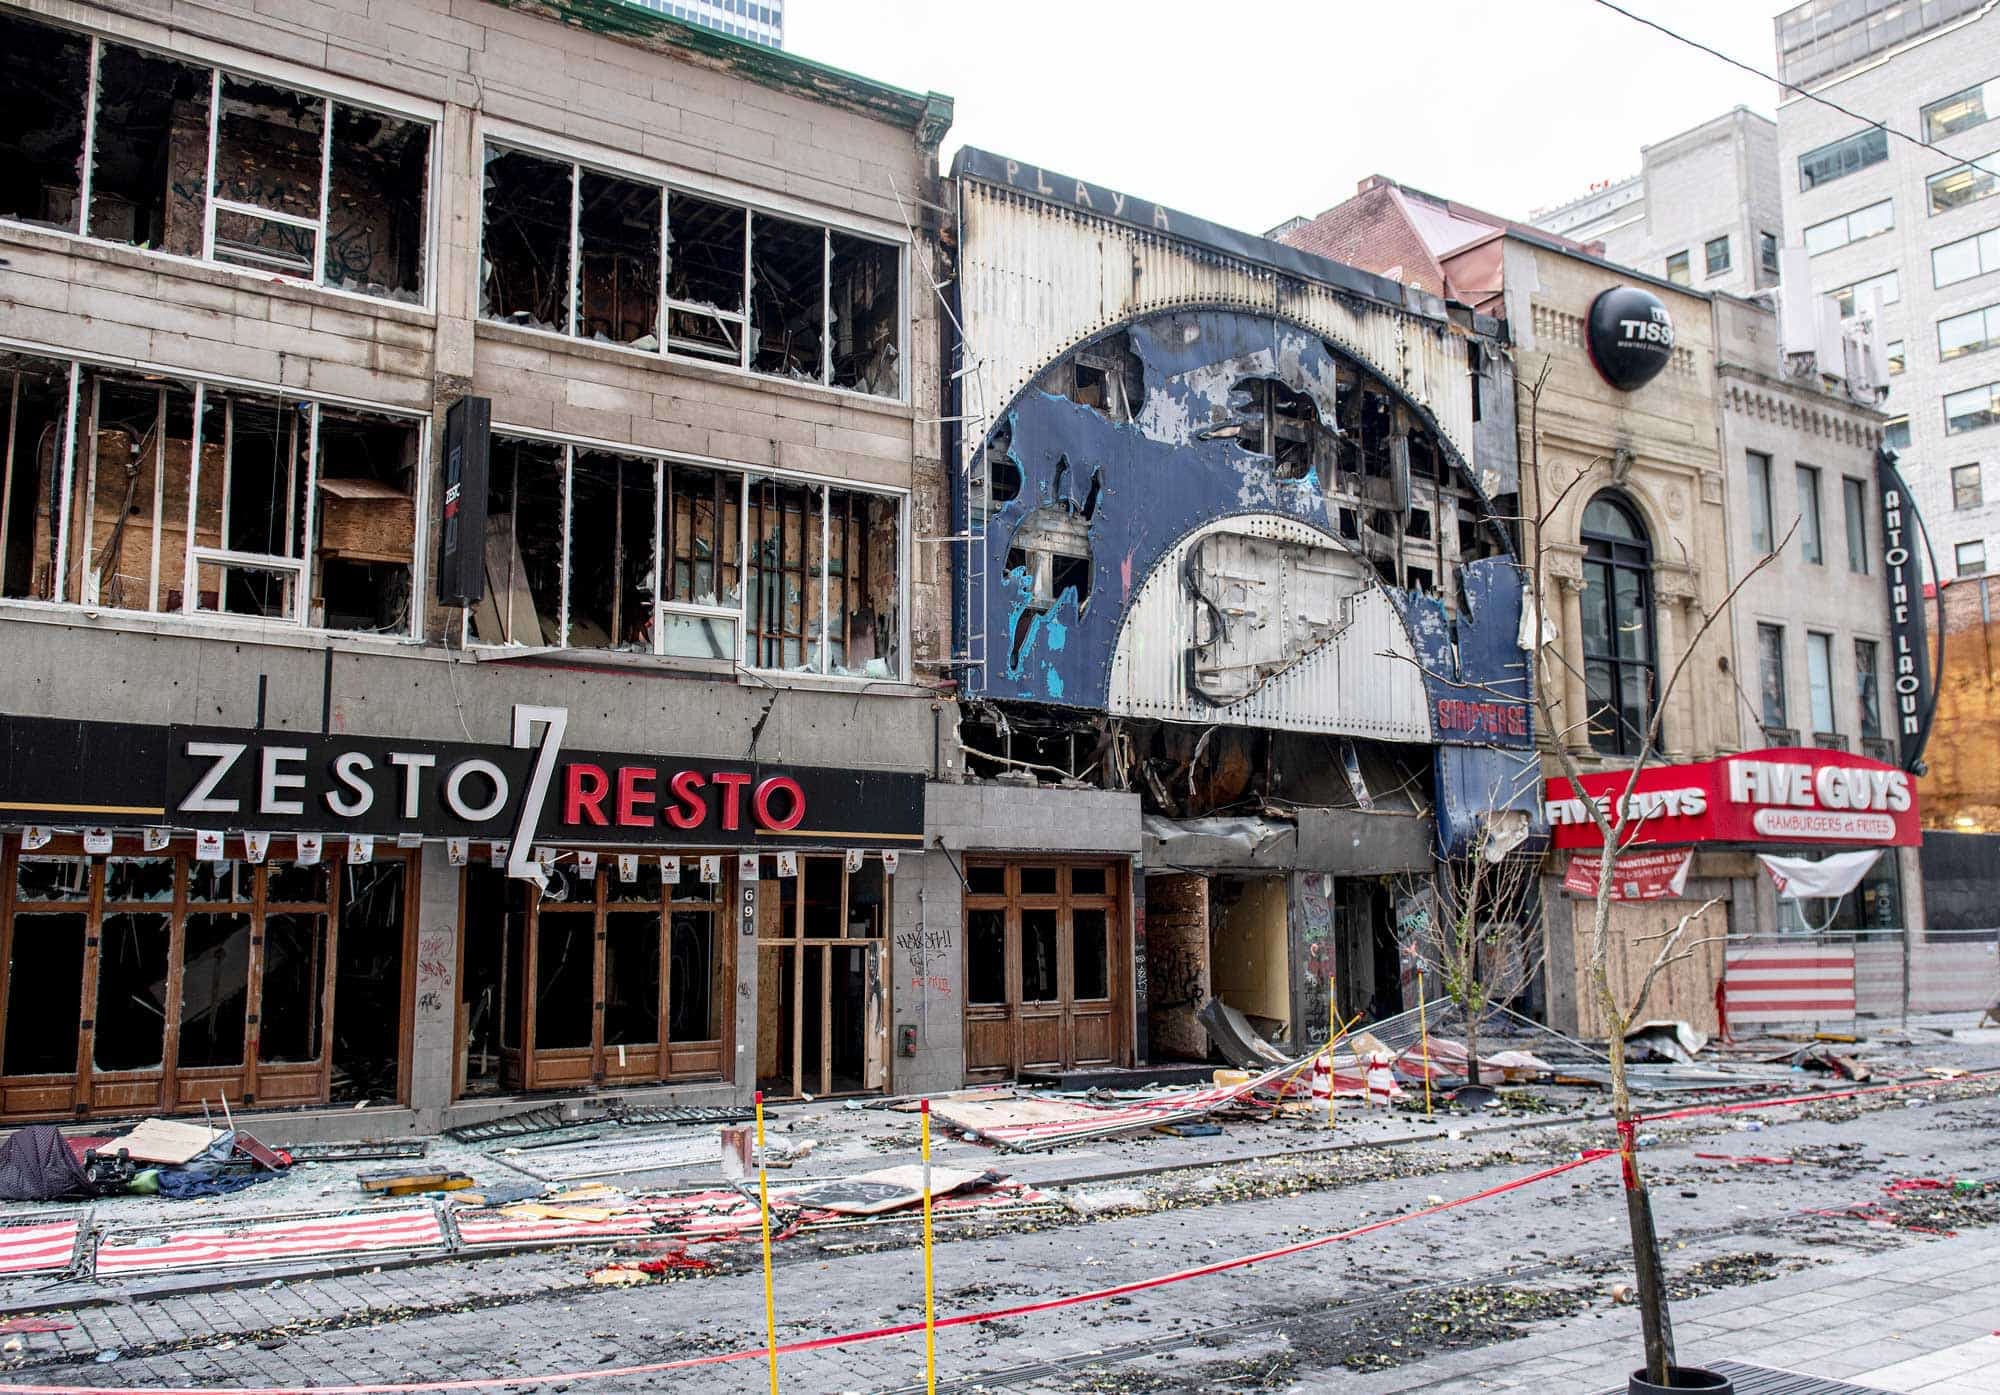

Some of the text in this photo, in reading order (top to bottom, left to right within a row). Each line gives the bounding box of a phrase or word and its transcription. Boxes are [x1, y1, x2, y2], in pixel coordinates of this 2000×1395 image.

[1006, 159, 1169, 232] PLAYA
[176, 742, 508, 822] ZESTO
[564, 763, 806, 832] RESTO
[1546, 787, 1707, 826] FIVE GUYS
[1728, 759, 1911, 812] FIVE GUYS
[1767, 814, 1841, 833] HAMBURGERS
[1856, 818, 1889, 834] FRITES
